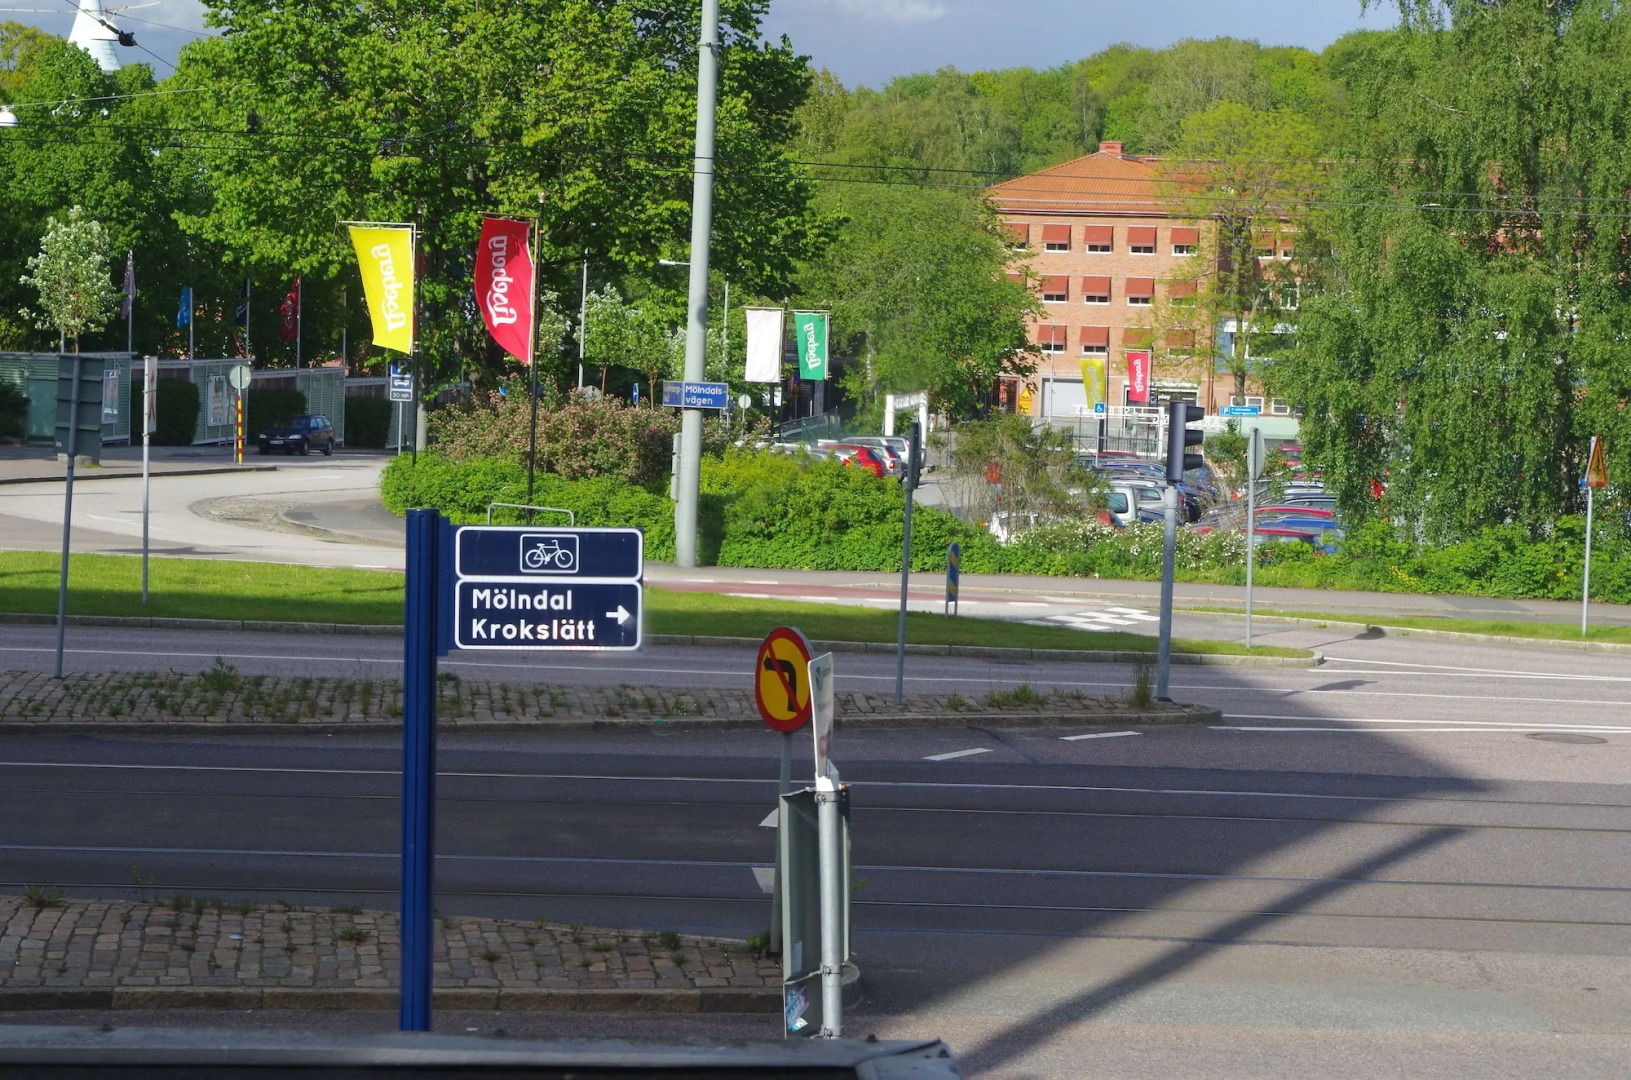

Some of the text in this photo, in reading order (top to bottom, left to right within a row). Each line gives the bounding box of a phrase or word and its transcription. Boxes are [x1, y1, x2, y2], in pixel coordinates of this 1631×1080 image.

[685, 385, 727, 395] Mölndals-
[685, 396, 713, 405] vägen
[472, 588, 573, 610] Mölndal
[472, 618, 595, 640] Krokslätt
